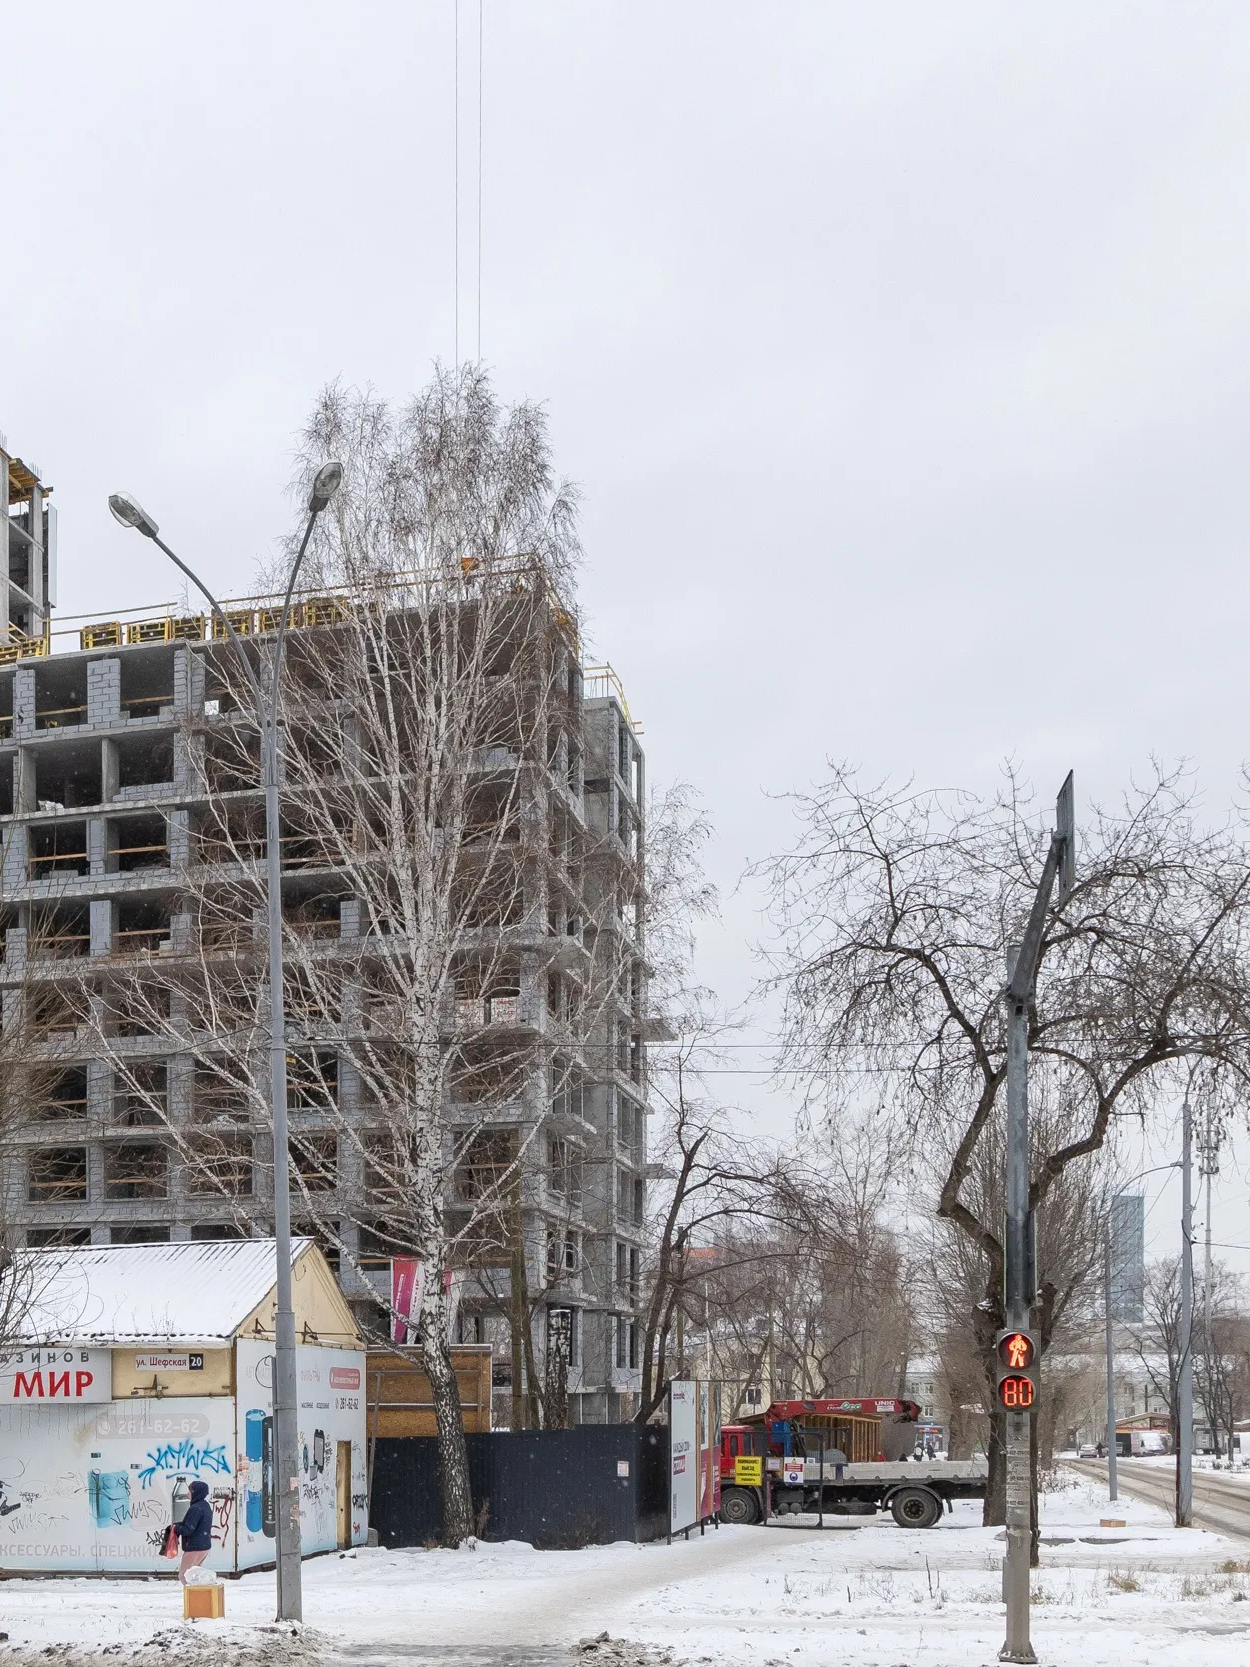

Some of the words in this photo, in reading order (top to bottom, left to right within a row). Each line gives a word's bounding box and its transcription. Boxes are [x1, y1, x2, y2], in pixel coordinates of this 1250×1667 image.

[136, 1358, 147, 1368] ул.
[149, 1356, 187, 1369] Шефская
[190, 1356, 203, 1367] 20
[13, 1370, 94, 1398] МИР
[1004, 1379, 1033, 1406] 80
[118, 1418, 200, 1435] 261-62-62
